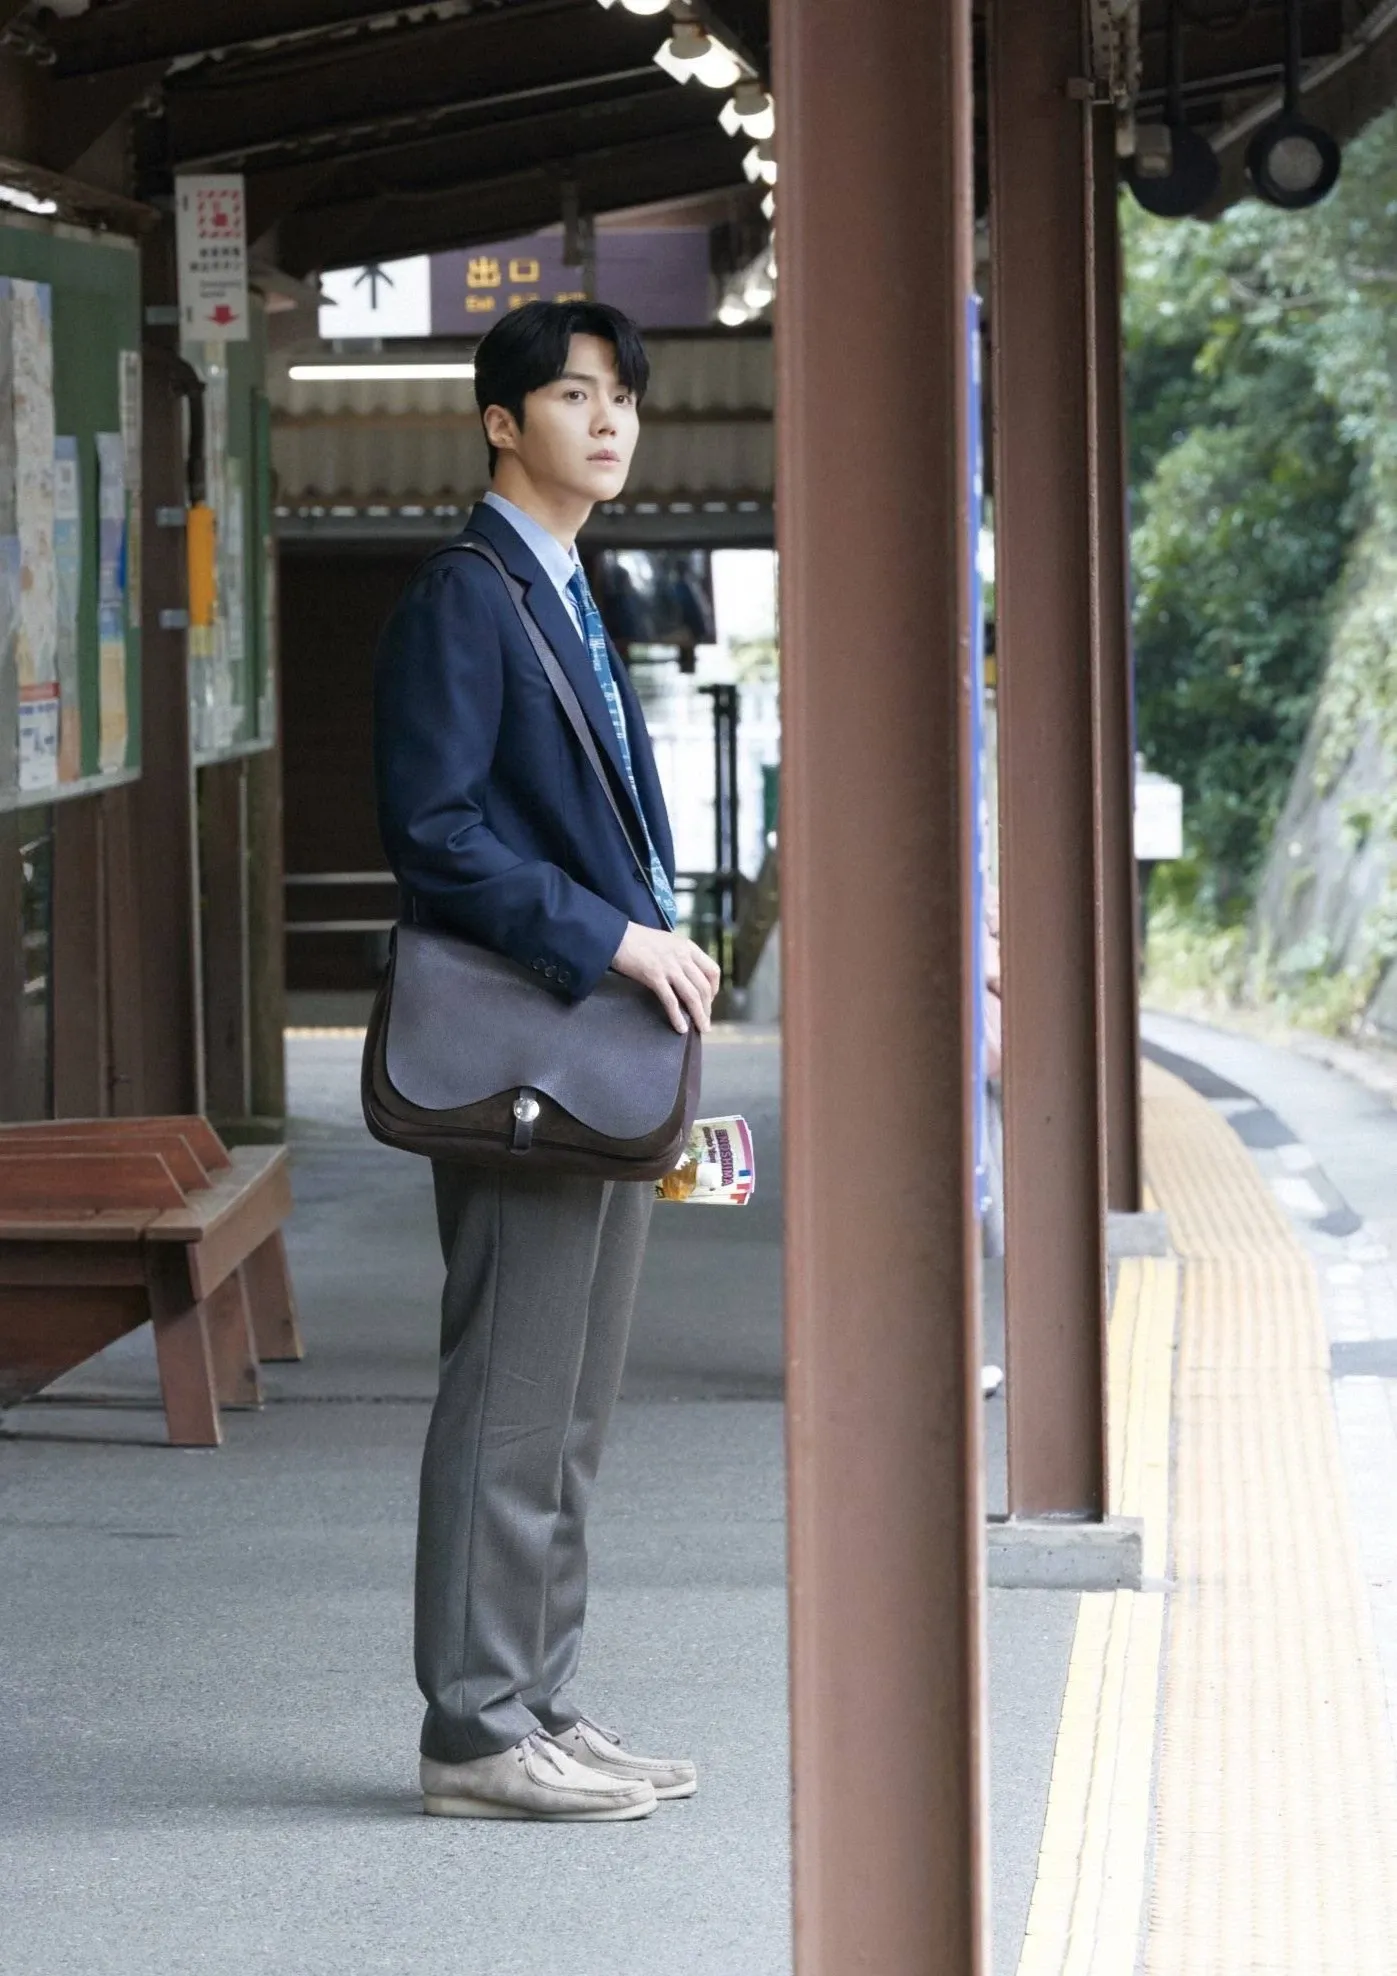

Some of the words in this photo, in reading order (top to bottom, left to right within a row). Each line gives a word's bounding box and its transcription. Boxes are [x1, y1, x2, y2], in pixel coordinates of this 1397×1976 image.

[467, 256, 539, 288] 出口
[465, 295, 496, 312] Exit
[714, 1129, 734, 1187] ENOSHIMA
